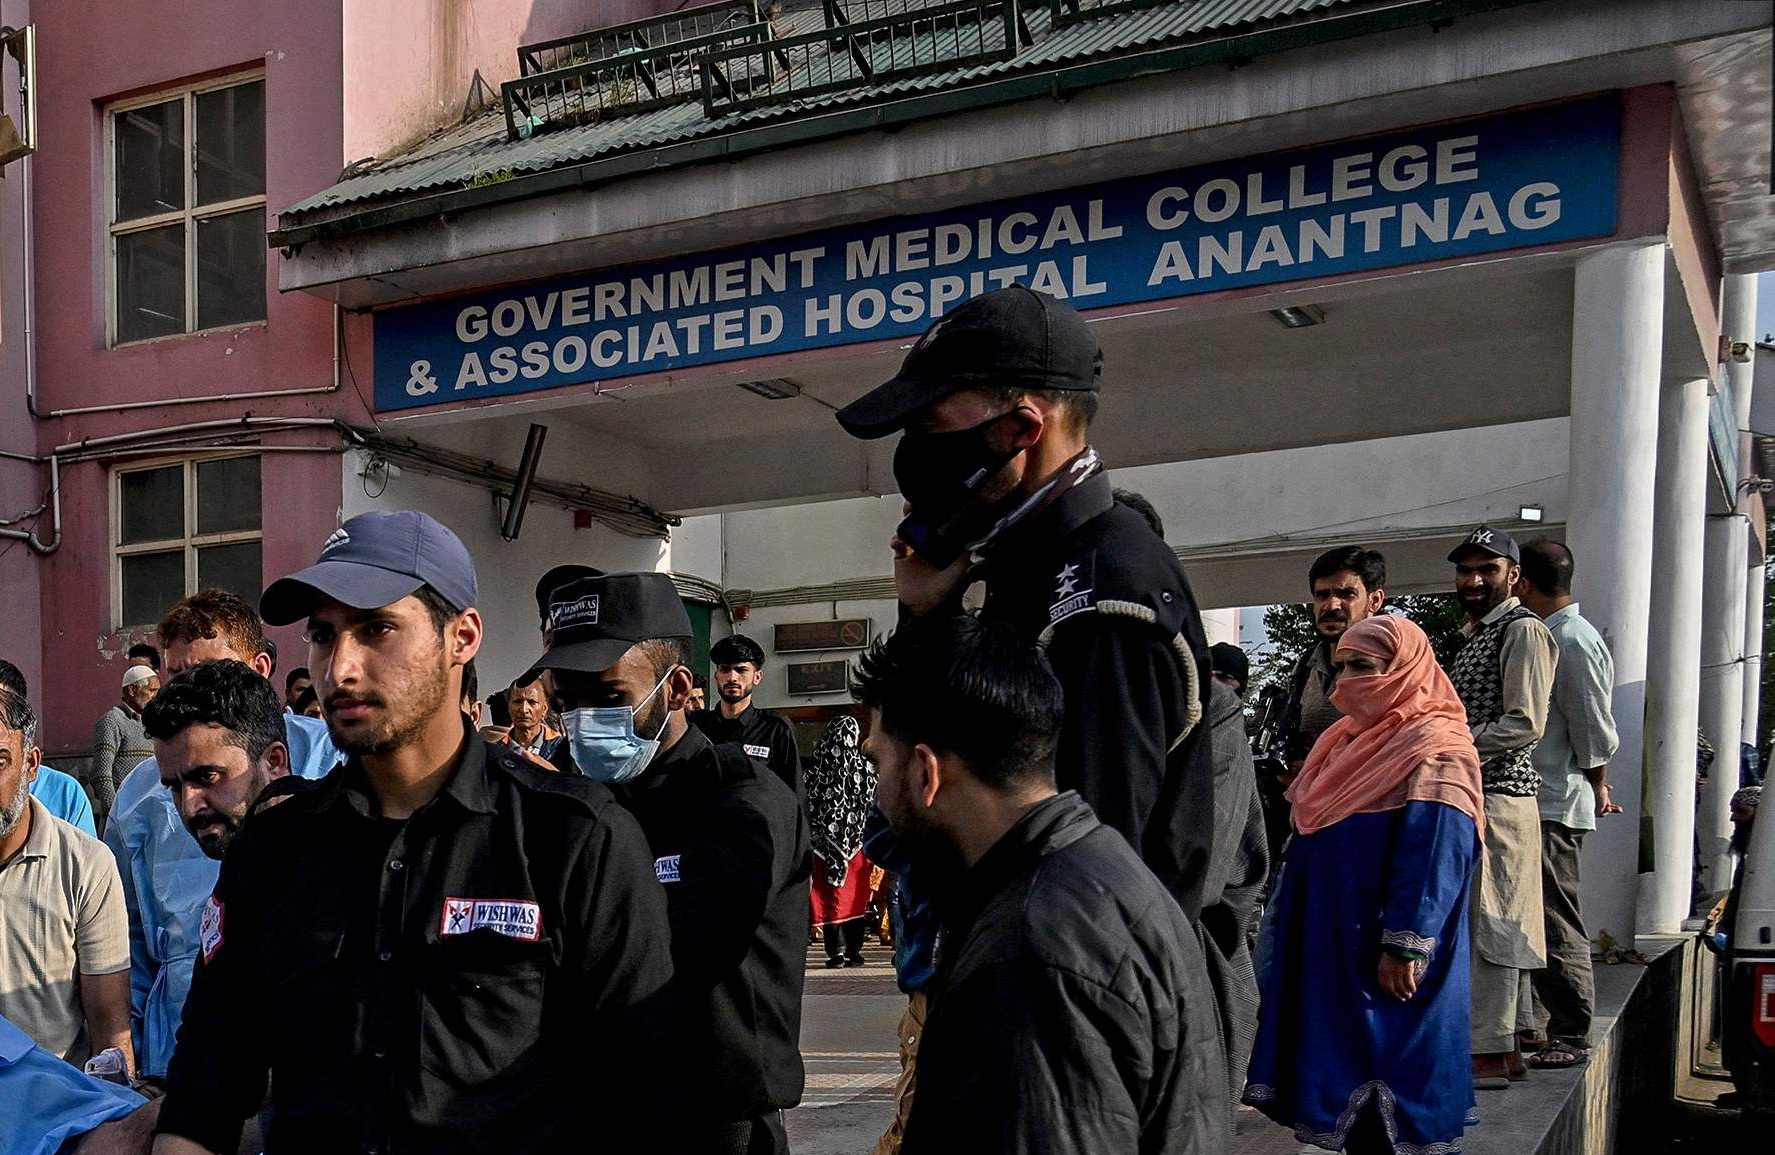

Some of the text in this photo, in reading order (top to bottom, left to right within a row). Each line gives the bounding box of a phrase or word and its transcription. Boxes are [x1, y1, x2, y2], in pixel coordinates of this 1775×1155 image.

[455, 135, 1479, 343] GOVERNMENT MEDICAL COLLEGE
[405, 182, 1561, 397] & ASSOCIATED HOSPITAL ANANTNAG
[1049, 594, 1089, 622] SECURITY
[478, 904, 535, 924] WISHWAS
[504, 924, 534, 934] SERVICES
